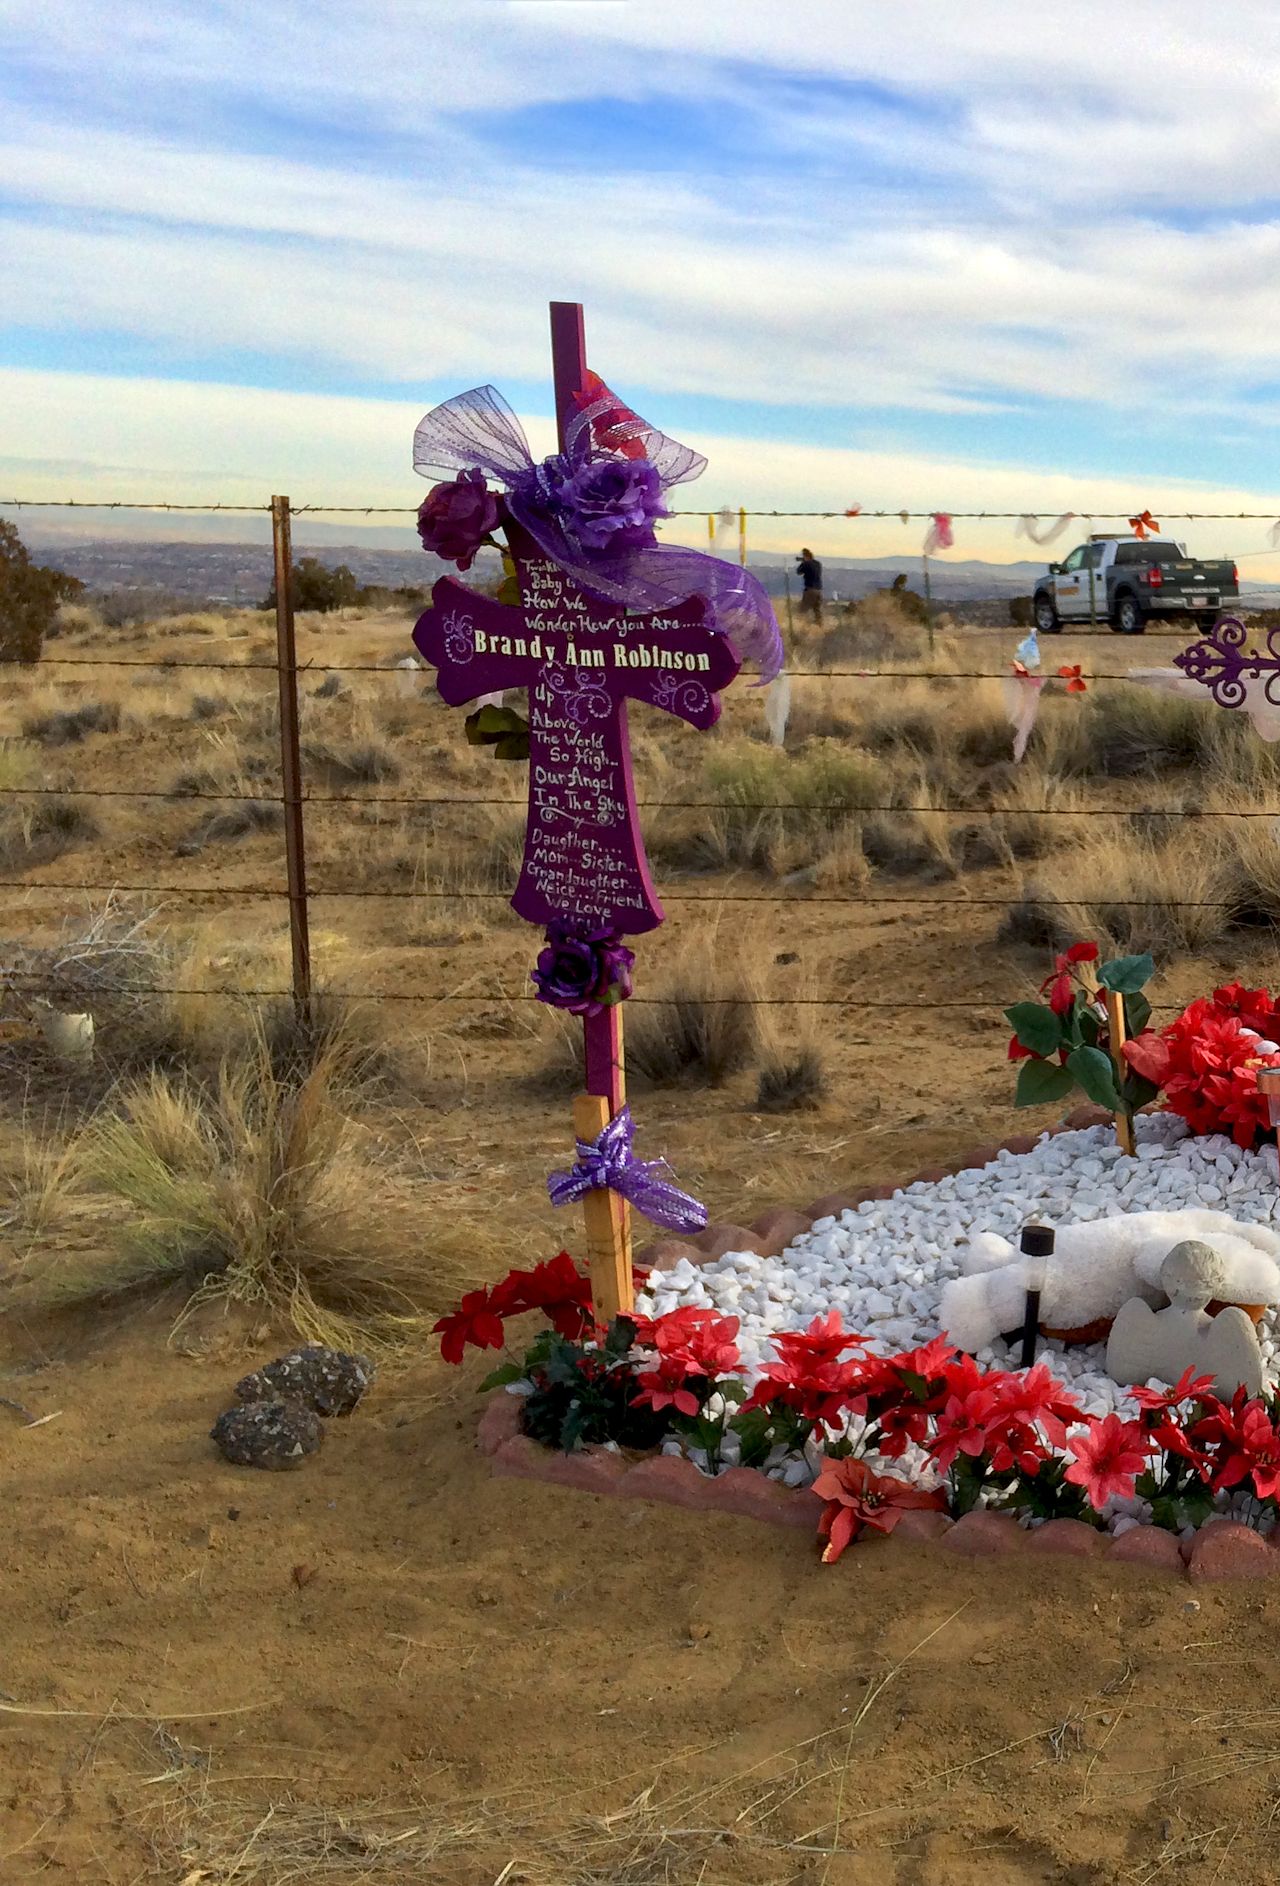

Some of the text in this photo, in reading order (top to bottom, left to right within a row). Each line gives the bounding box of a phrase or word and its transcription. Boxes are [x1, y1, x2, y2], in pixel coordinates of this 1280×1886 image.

[530, 572, 562, 595] Baby
[522, 588, 587, 611] How We
[524, 612, 576, 632] Wonder
[577, 614, 616, 633] How
[474, 629, 711, 672] Brandy Ann Robinson
[535, 683, 554, 708] Up
[532, 729, 604, 749] The World
[549, 747, 569, 763] So
[535, 765, 614, 797] Our Angel
[564, 789, 594, 811] The
[545, 893, 612, 918] We Love
